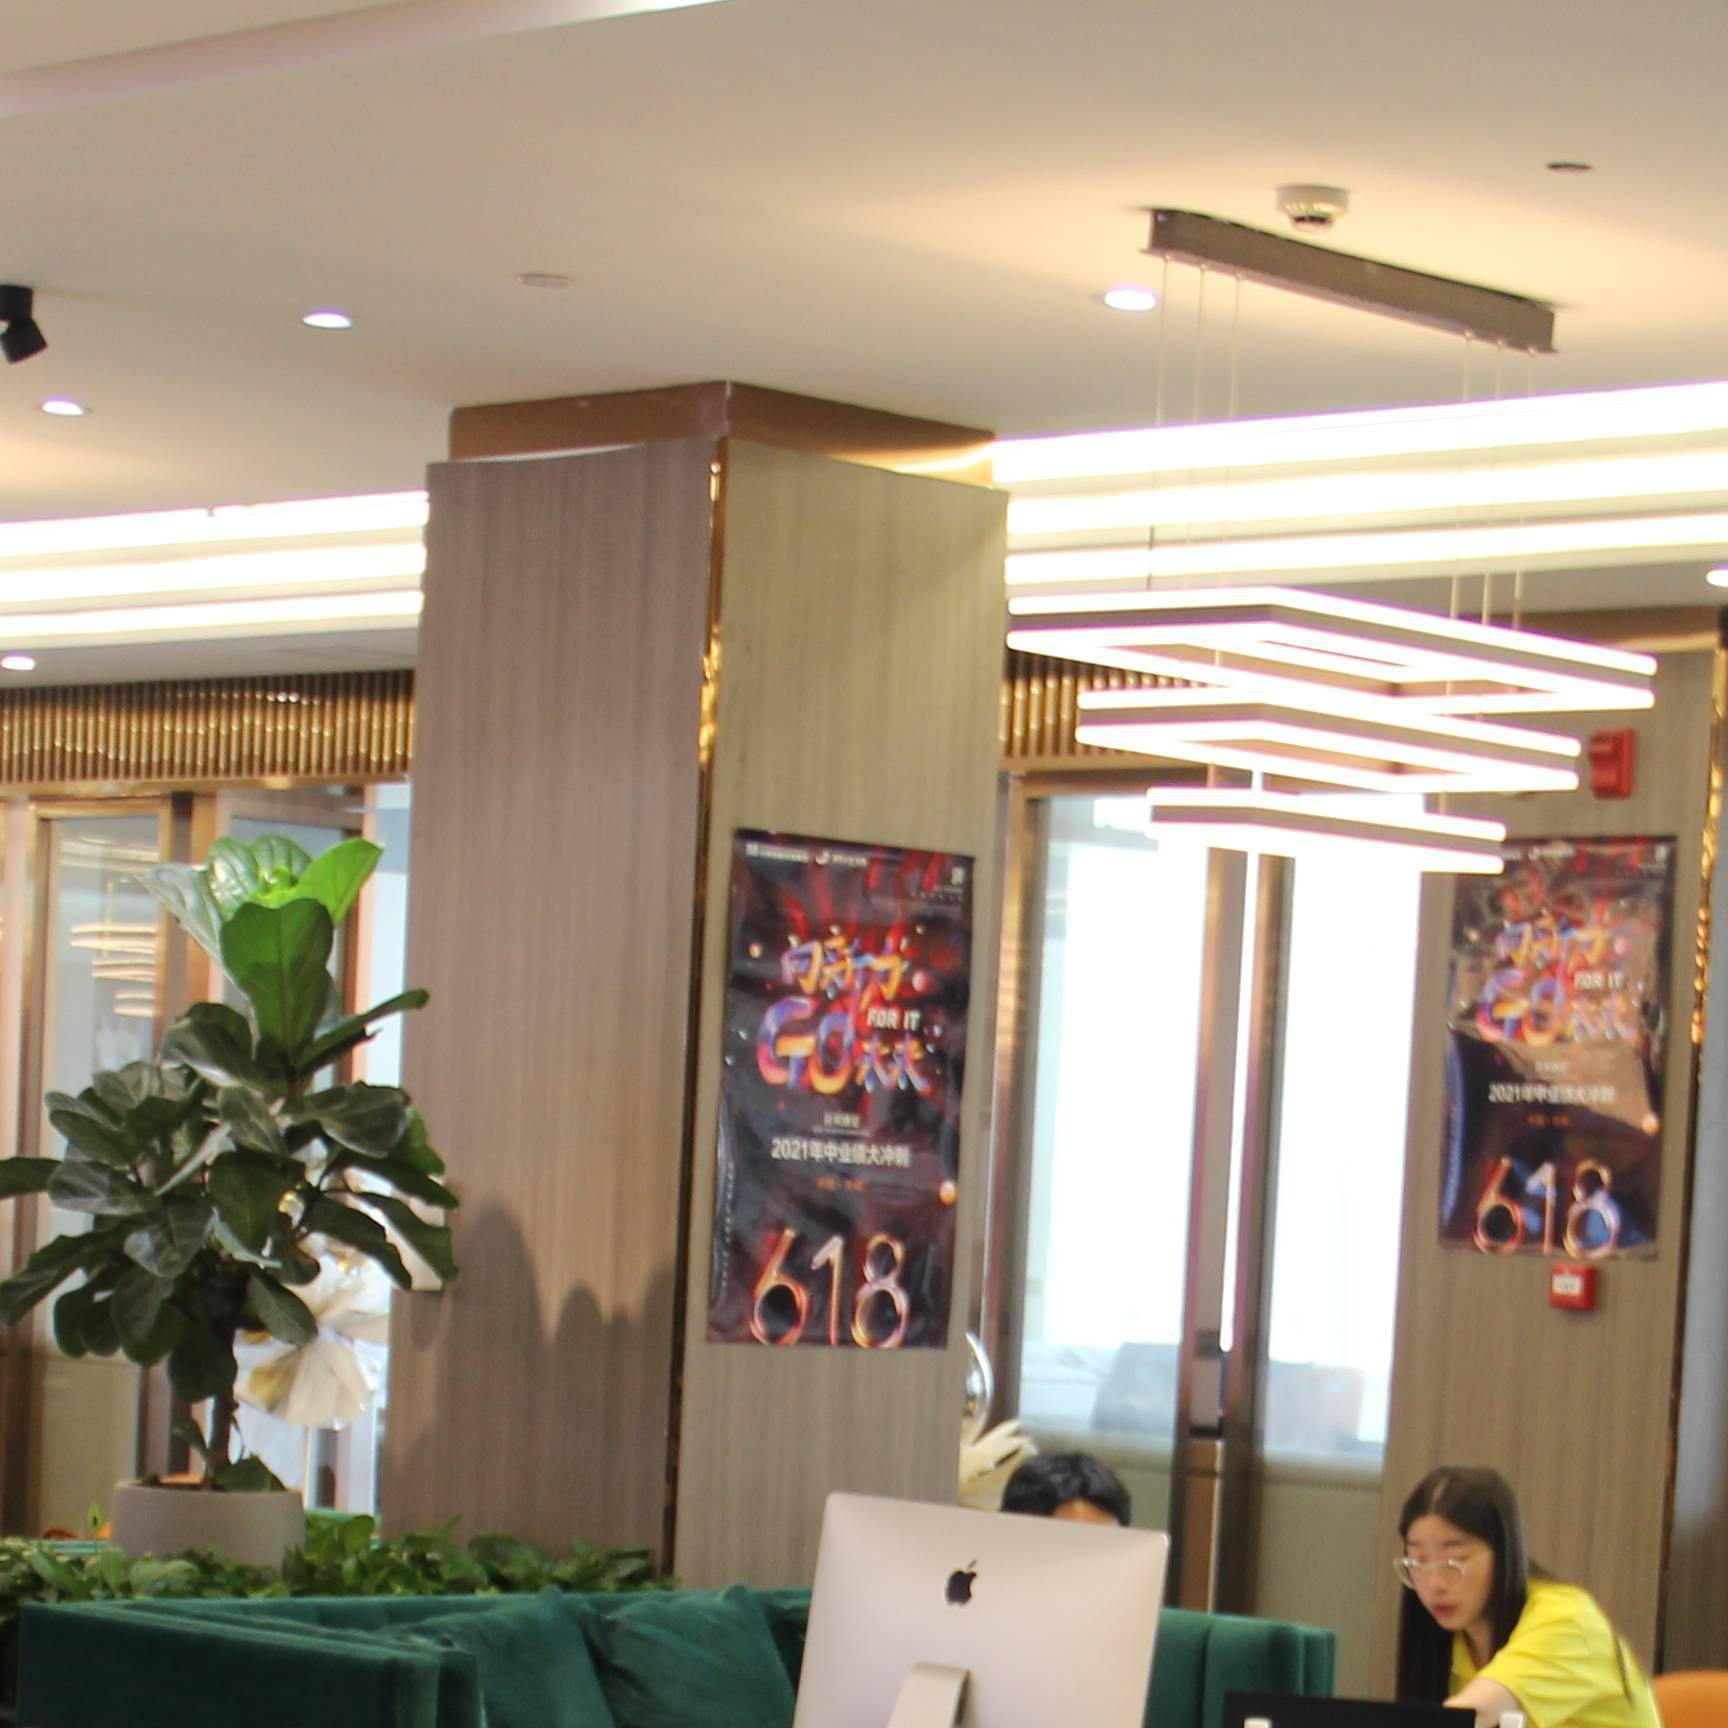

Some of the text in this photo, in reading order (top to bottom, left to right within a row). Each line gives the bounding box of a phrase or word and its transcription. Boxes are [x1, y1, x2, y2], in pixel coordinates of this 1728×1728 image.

[867, 1006, 921, 1031] FOR IT
[1473, 1157, 1621, 1260] 618
[749, 1227, 911, 1349] 618
